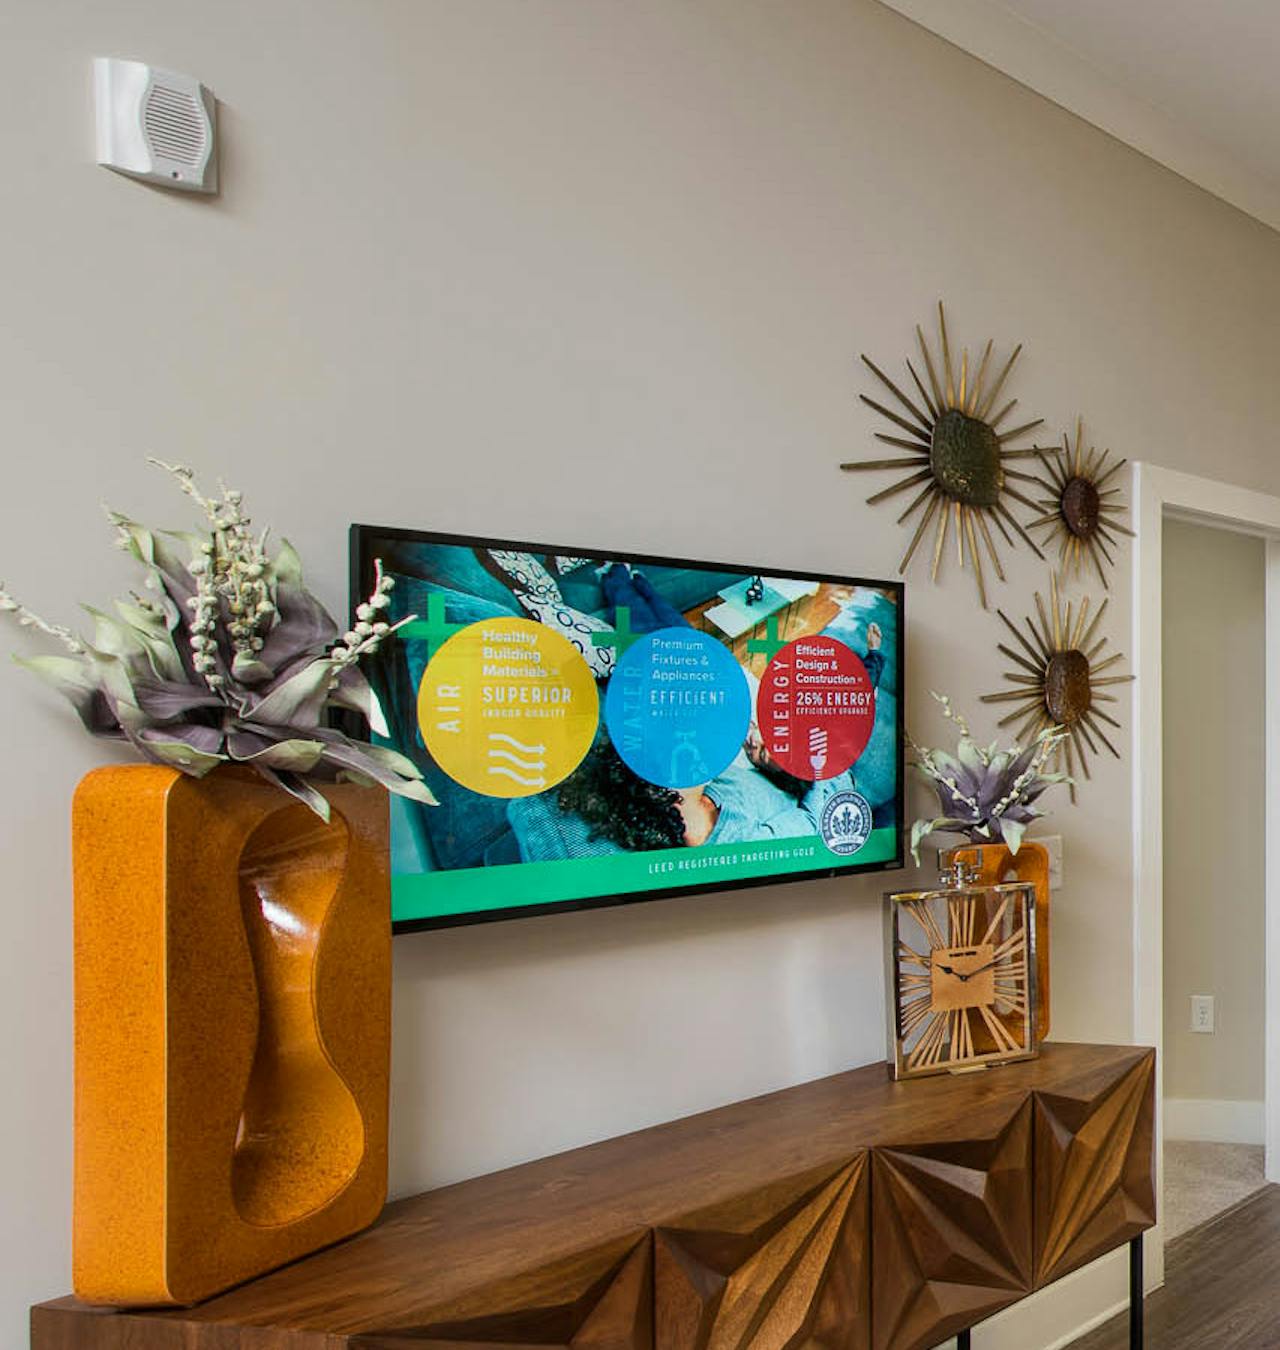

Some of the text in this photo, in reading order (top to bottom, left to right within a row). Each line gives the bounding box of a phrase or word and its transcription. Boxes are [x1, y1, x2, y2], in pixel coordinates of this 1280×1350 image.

[482, 630, 538, 645] Healthy
[652, 638, 703, 650] Premium
[482, 647, 541, 664] Building
[796, 645, 835, 656] Efficient
[652, 653, 709, 666] Fixtures &
[796, 659, 838, 672] Design &
[482, 665, 547, 677] Materials
[652, 669, 715, 682] Appliances
[796, 673, 856, 684] Construction
[482, 686, 572, 703] SUPERIOR
[650, 690, 725, 705] EFFICIENT
[796, 692, 871, 706] 26% ENERGY
[437, 685, 461, 733] AIR
[623, 666, 642, 752] WATER
[773, 660, 790, 753] ENERGY
[796, 707, 837, 715] EFFICIENCY
[525, 709, 566, 718] QUALITY
[648, 863, 674, 874] LEED
[678, 854, 738, 870] REGISTERED
[741, 850, 790, 863] TARGETING
